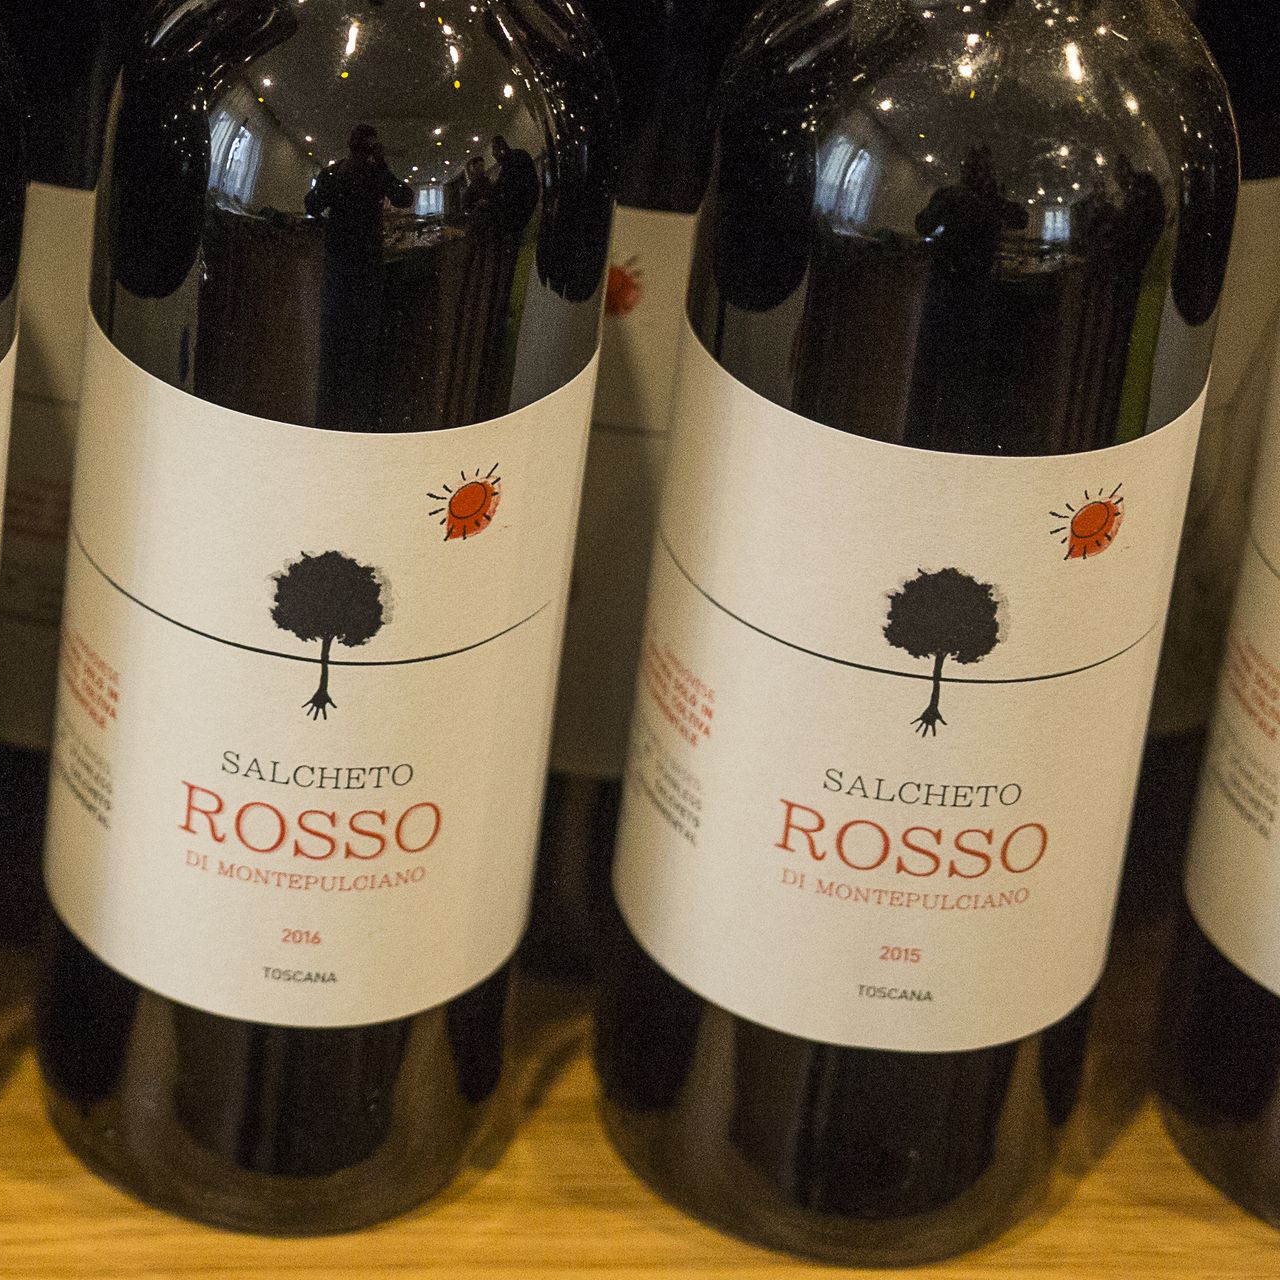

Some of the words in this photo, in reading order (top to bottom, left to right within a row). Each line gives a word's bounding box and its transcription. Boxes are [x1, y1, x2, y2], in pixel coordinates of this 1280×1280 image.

[220, 750, 415, 791] SALCHETO
[823, 767, 1023, 809] SALCHETO
[178, 780, 443, 862] ROSSO
[775, 798, 1048, 879] ROSSO
[185, 848, 210, 871] DI
[217, 860, 427, 892] MONTEPULCIANO
[781, 868, 806, 889] DI
[815, 877, 1030, 911] MONTEPULCIANO
[281, 928, 322, 946] 2016
[879, 944, 921, 964] 2015
[263, 967, 338, 985] TOSCANA
[858, 984, 933, 1003] TOSCANA
